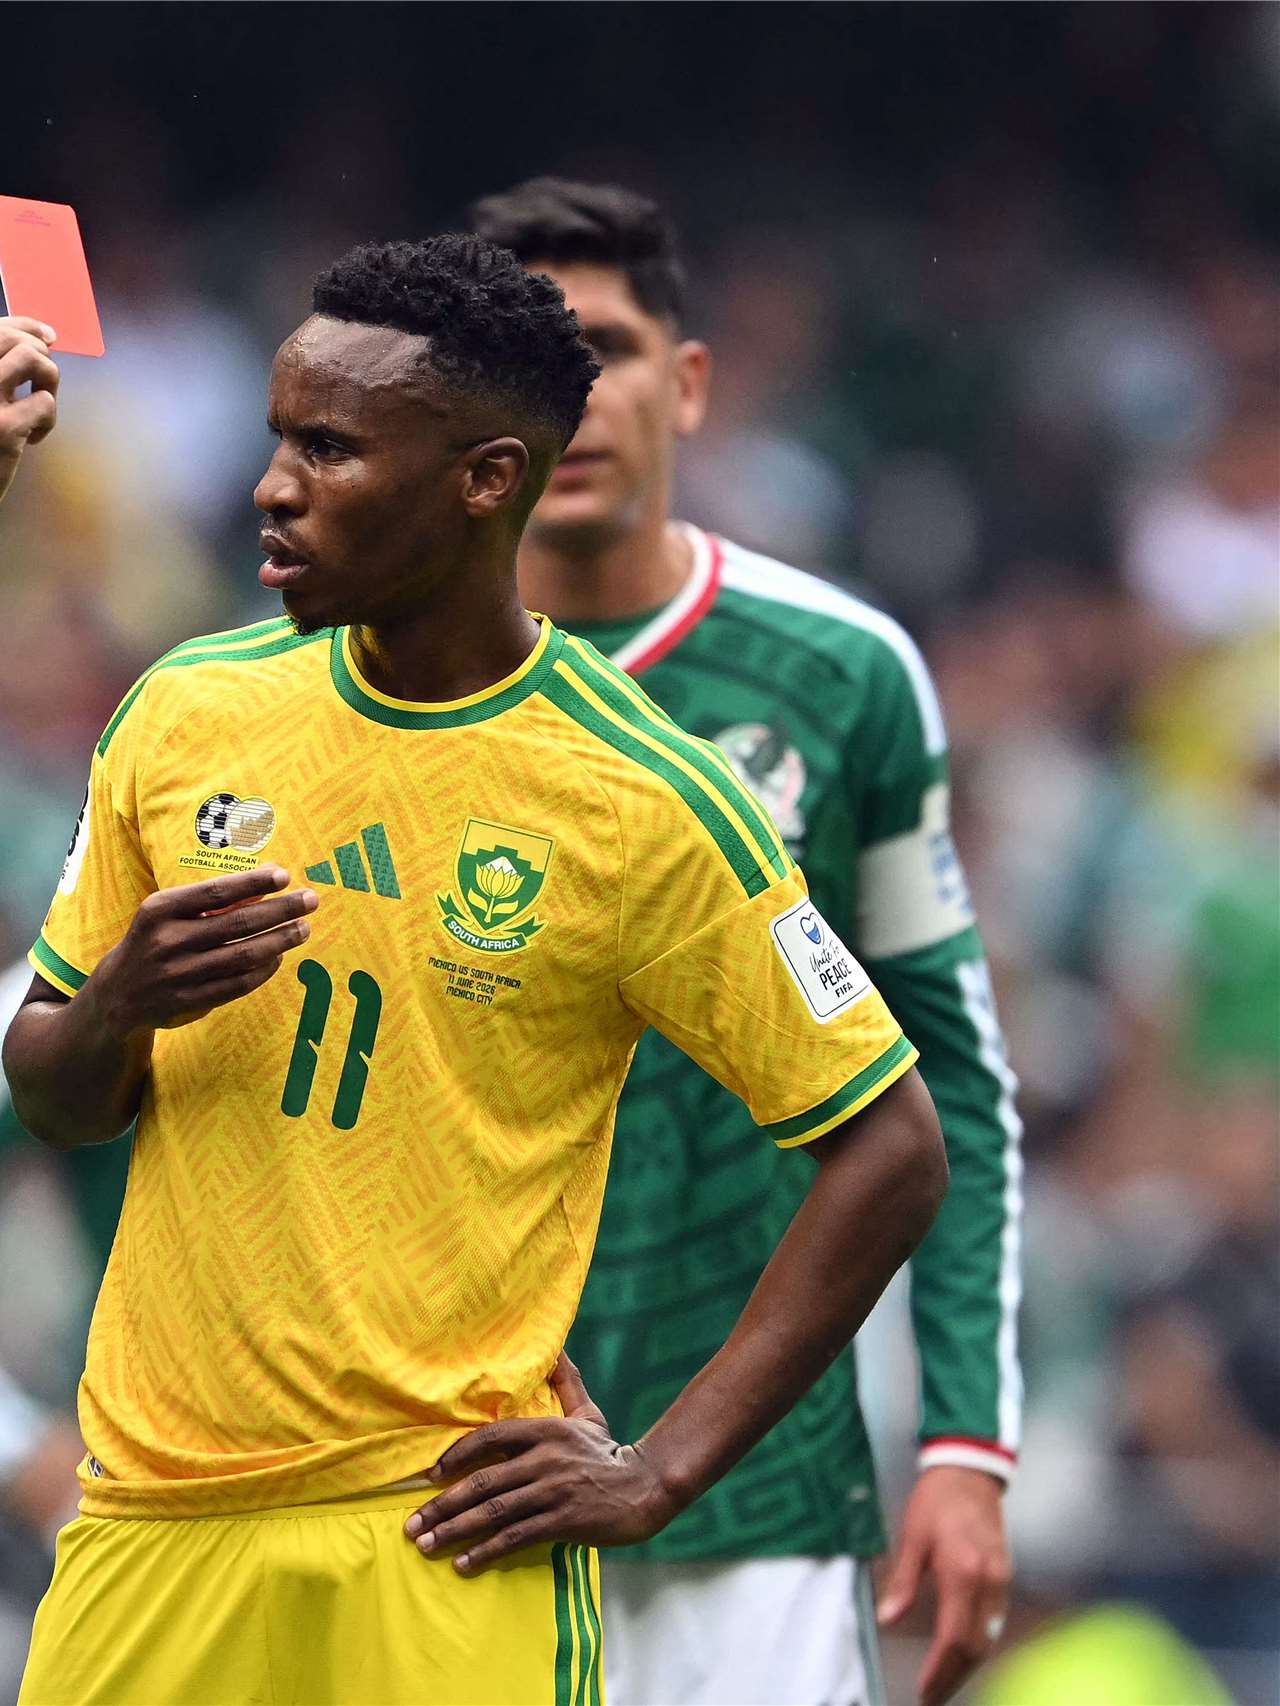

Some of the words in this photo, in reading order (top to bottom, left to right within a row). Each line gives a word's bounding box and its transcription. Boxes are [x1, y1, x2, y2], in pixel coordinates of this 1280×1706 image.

[179, 857, 216, 867] FOOTBALL
[218, 862, 255, 871] ASSOCI
[196, 850, 222, 859] SOUTH
[223, 854, 257, 864] AFRICAN
[448, 921, 480, 946] SOUTH
[480, 938, 519, 949] AFRICA
[809, 948, 833, 973] Unite
[428, 957, 457, 972] MEXICO
[470, 968, 494, 982] SOUTH
[495, 974, 521, 989] AFRICA
[819, 958, 852, 990] PEACE
[446, 986, 475, 1001] MEXICO
[476, 994, 493, 1005] CITY
[456, 976, 474, 989] JUNE
[475, 981, 496, 995] 2026
[835, 982, 854, 998] FIFA
[281, 959, 382, 1130] 11
